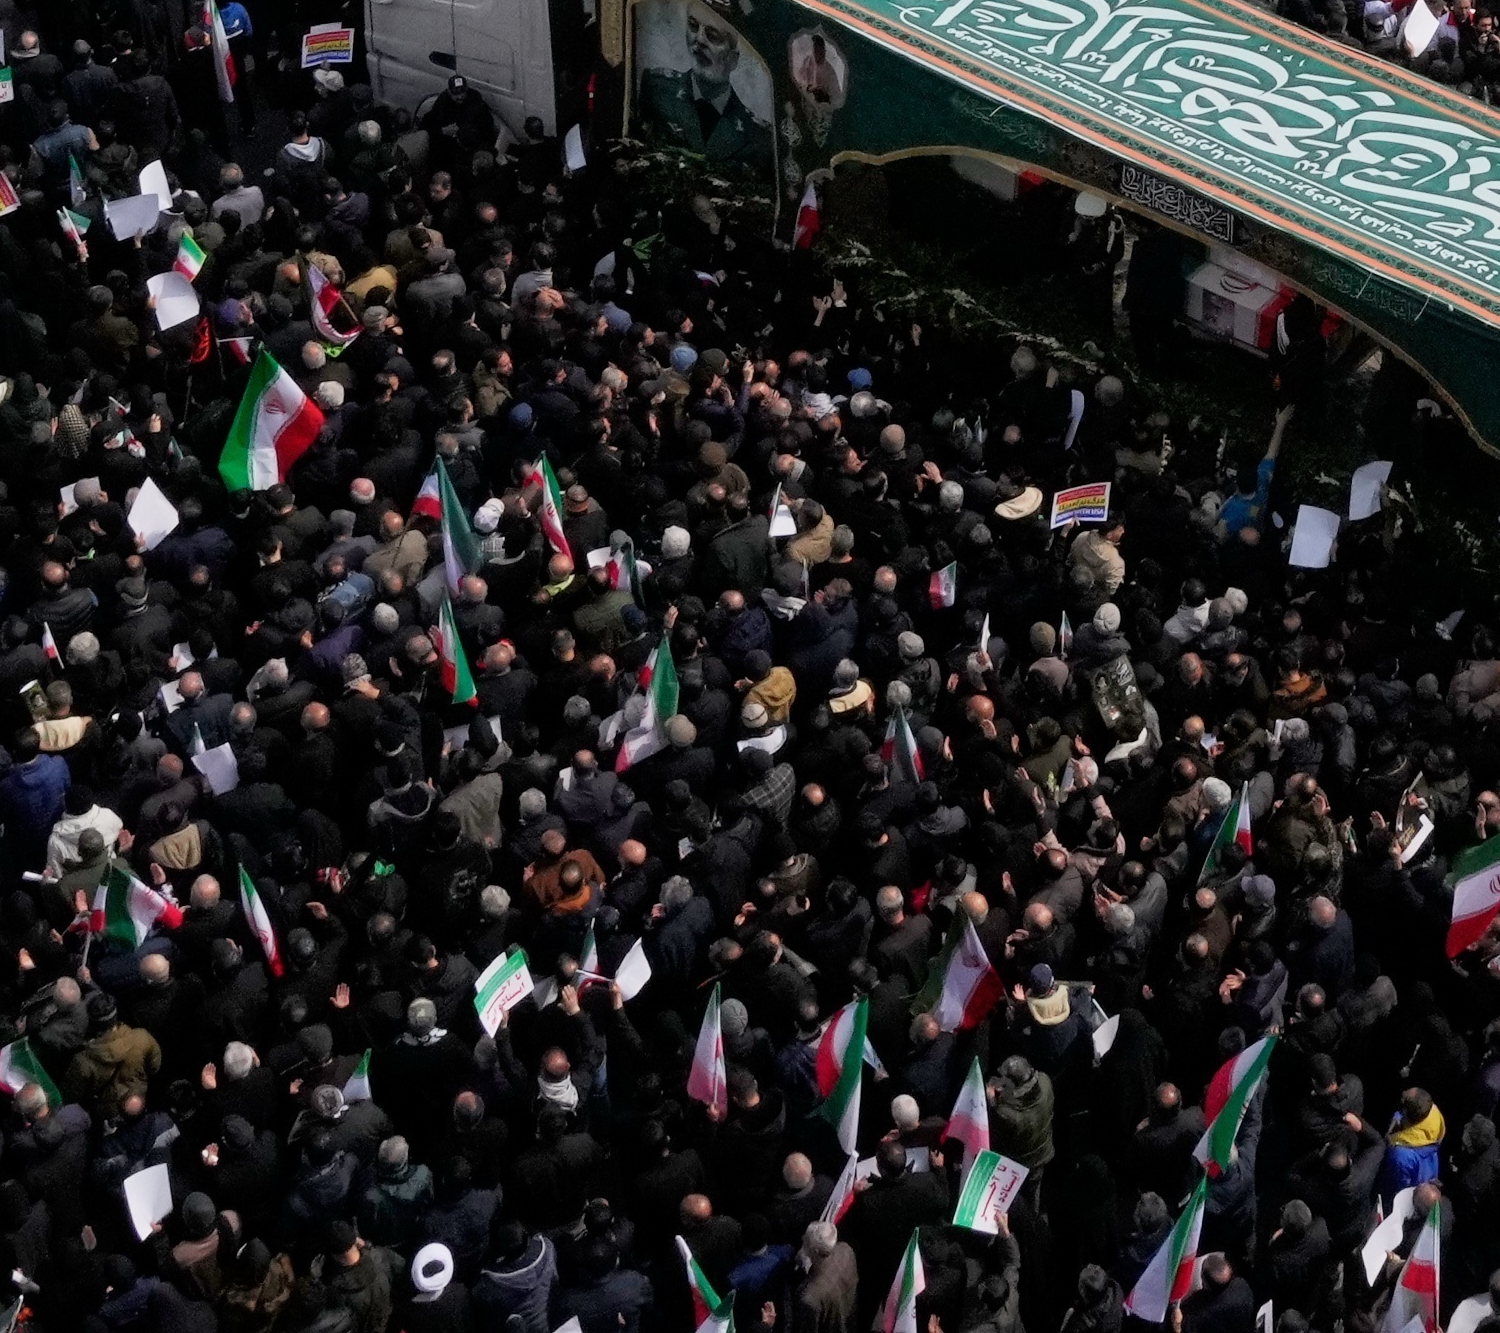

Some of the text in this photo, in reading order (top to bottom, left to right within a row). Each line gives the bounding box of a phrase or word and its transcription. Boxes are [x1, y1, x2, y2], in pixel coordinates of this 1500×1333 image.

[946, 28, 990, 46] موسی
[979, 39, 1034, 68] گفت:
[1024, 59, 1064, 82] چنین
[1058, 74, 1121, 109] نیست!
[1146, 113, 1221, 151] پروردگارم
[1223, 148, 1256, 166] من
[1290, 178, 1342, 206] بزودی
[1338, 204, 1364, 220] مرا
[1360, 215, 1414, 240] هدایت
[1409, 236, 1465, 262] خواهد
[1091, 507, 1105, 517] USA
